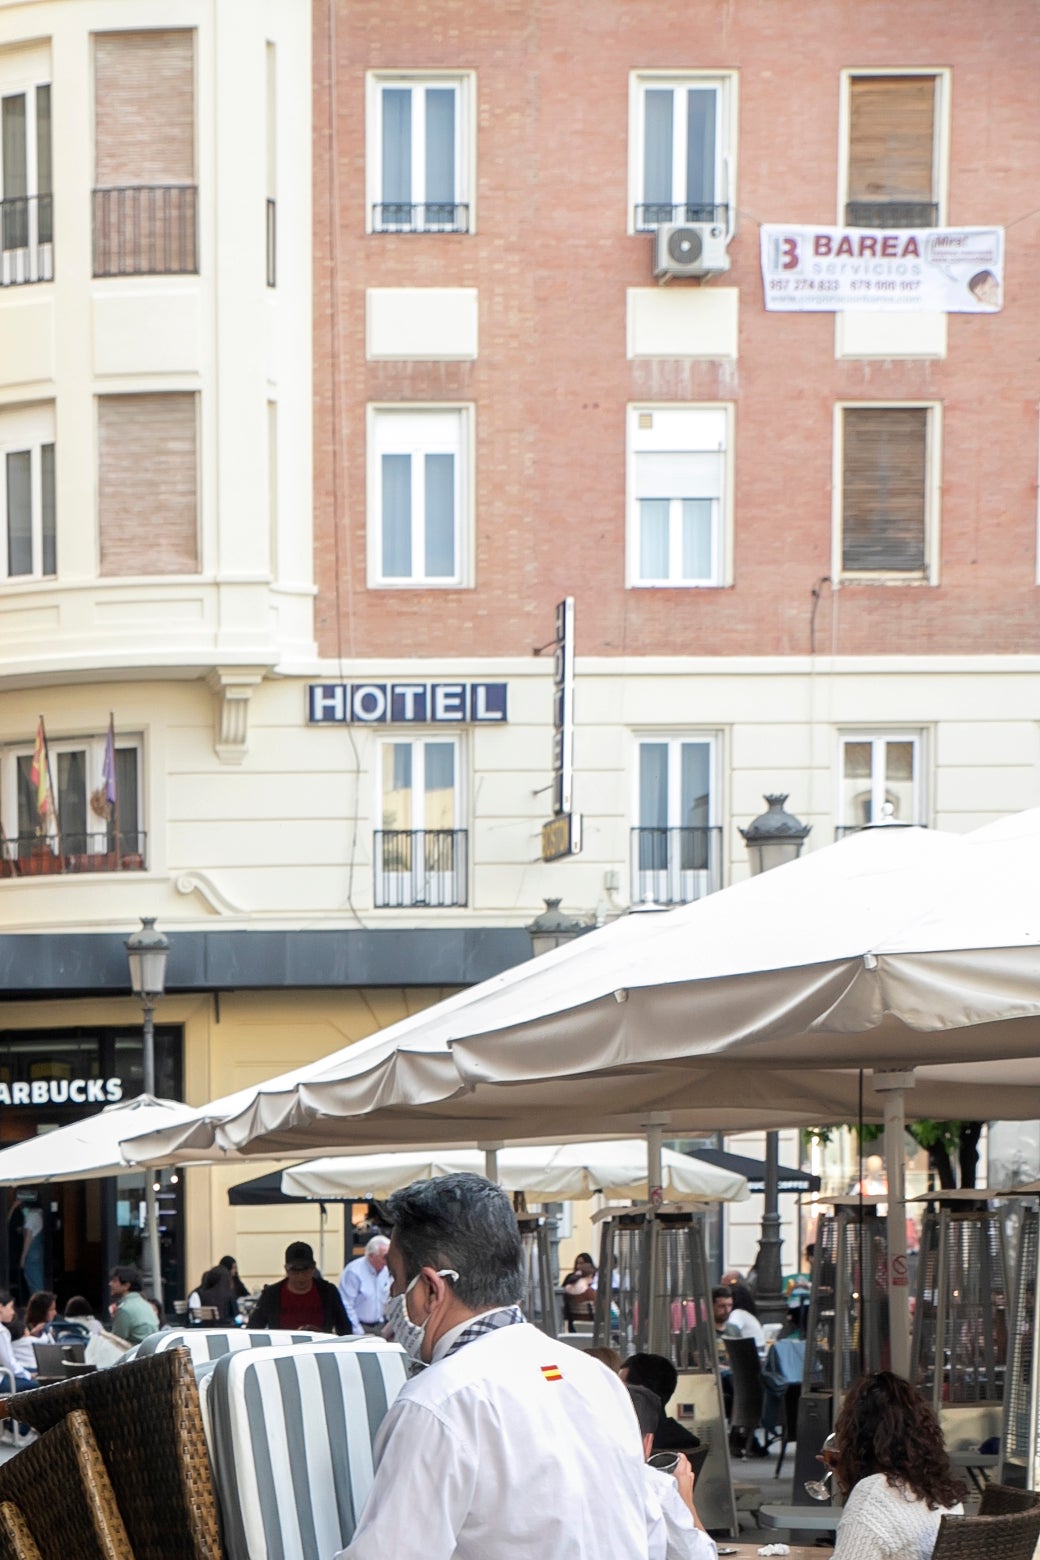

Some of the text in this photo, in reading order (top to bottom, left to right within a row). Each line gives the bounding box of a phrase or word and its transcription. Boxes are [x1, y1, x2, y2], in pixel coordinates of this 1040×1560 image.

[813, 235, 921, 258] BAREA
[812, 259, 922, 276] servicios
[313, 684, 503, 721] HOTEL
